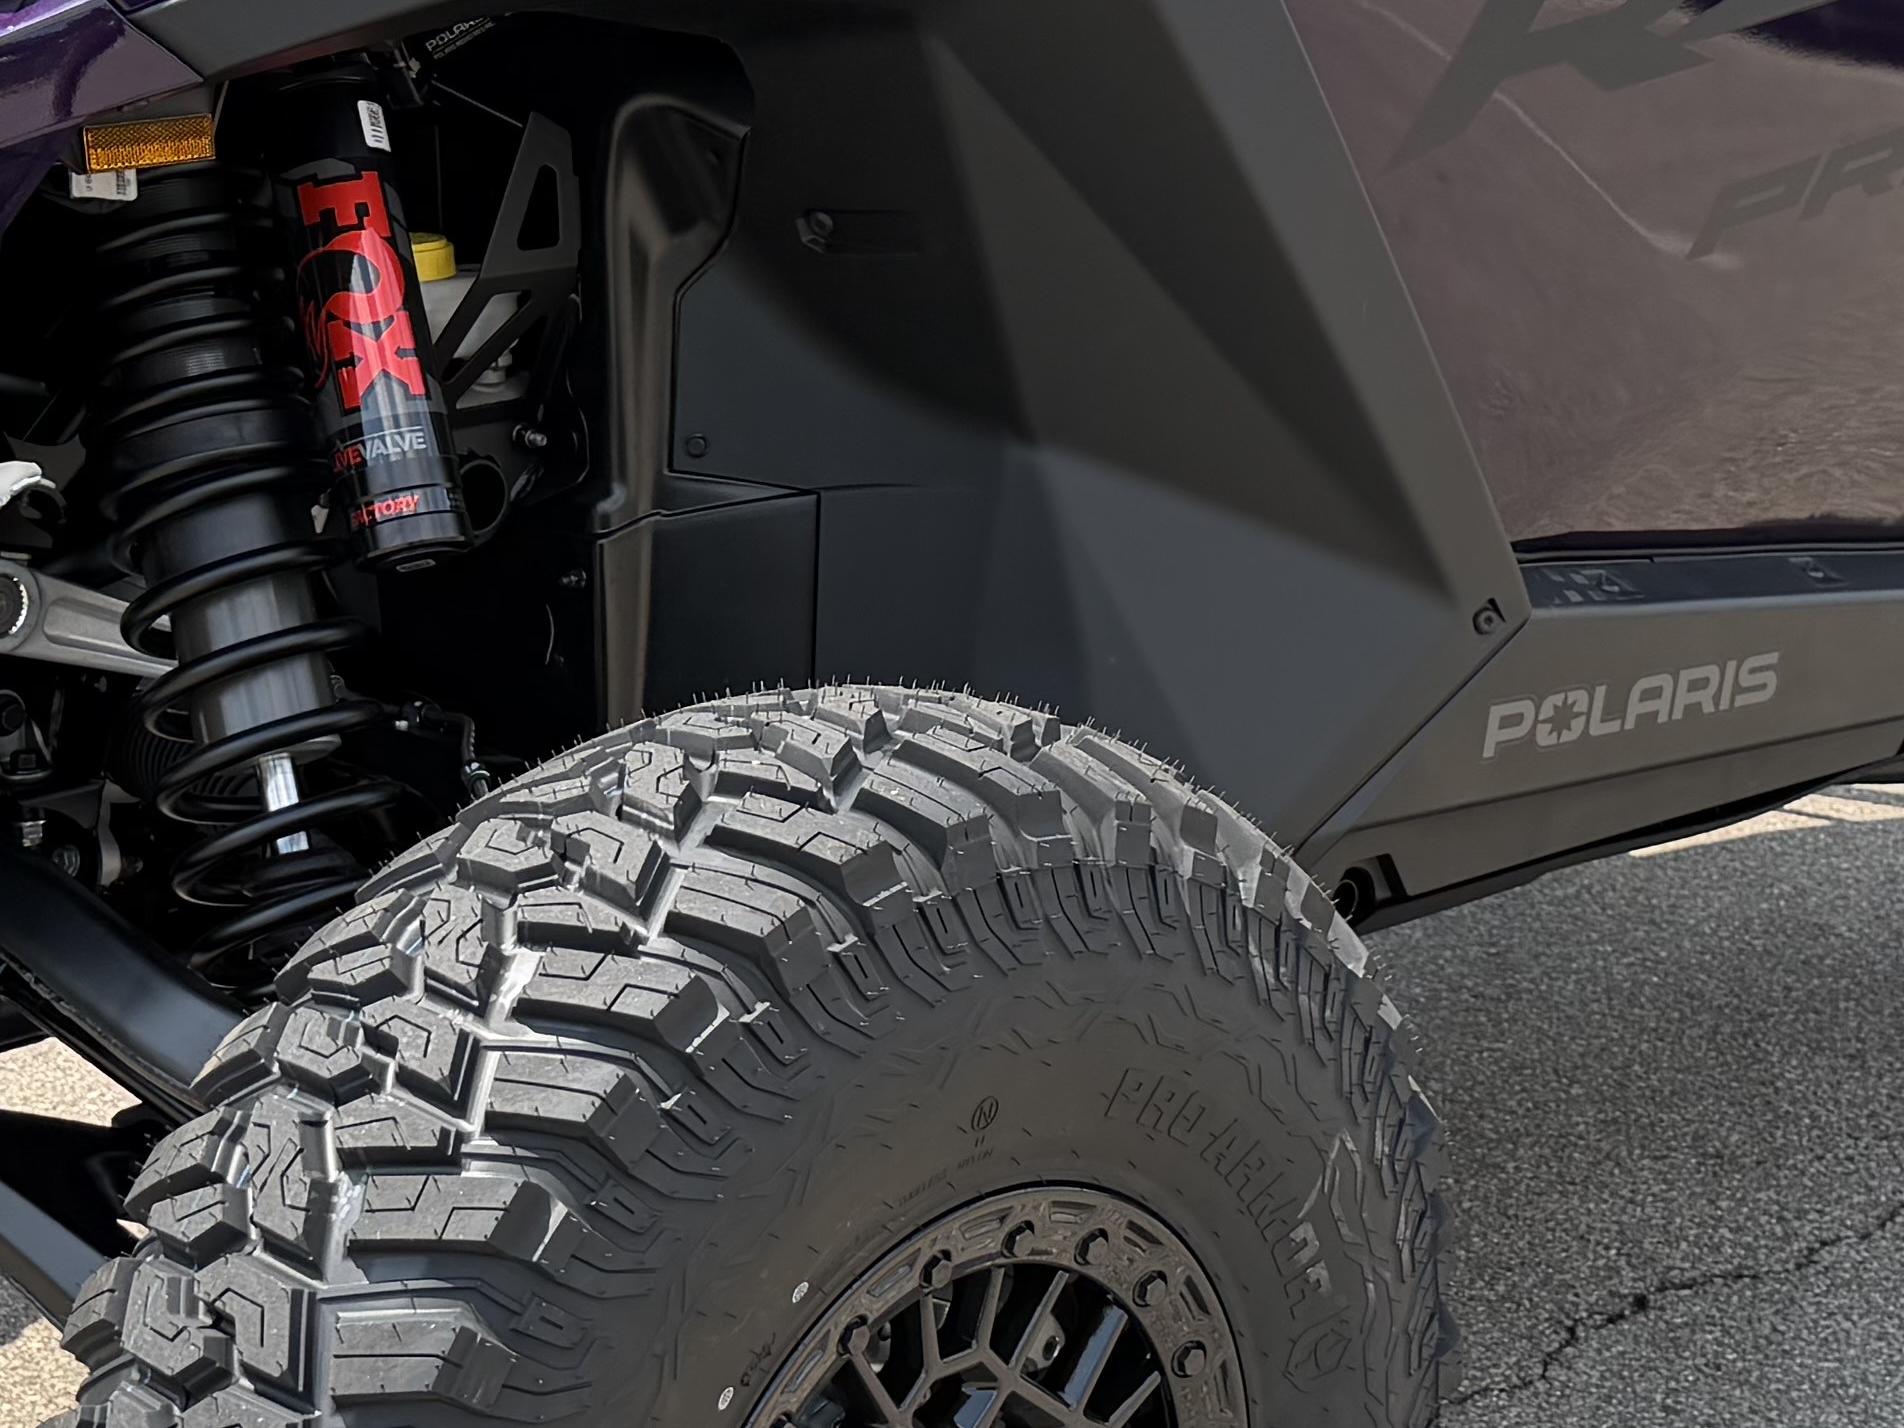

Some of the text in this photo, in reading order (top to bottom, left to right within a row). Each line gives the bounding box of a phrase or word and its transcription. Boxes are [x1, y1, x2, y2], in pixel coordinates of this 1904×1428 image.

[425, 17, 484, 52] POLA
[297, 171, 427, 410] FOX
[1481, 651, 1781, 759] POLARIS
